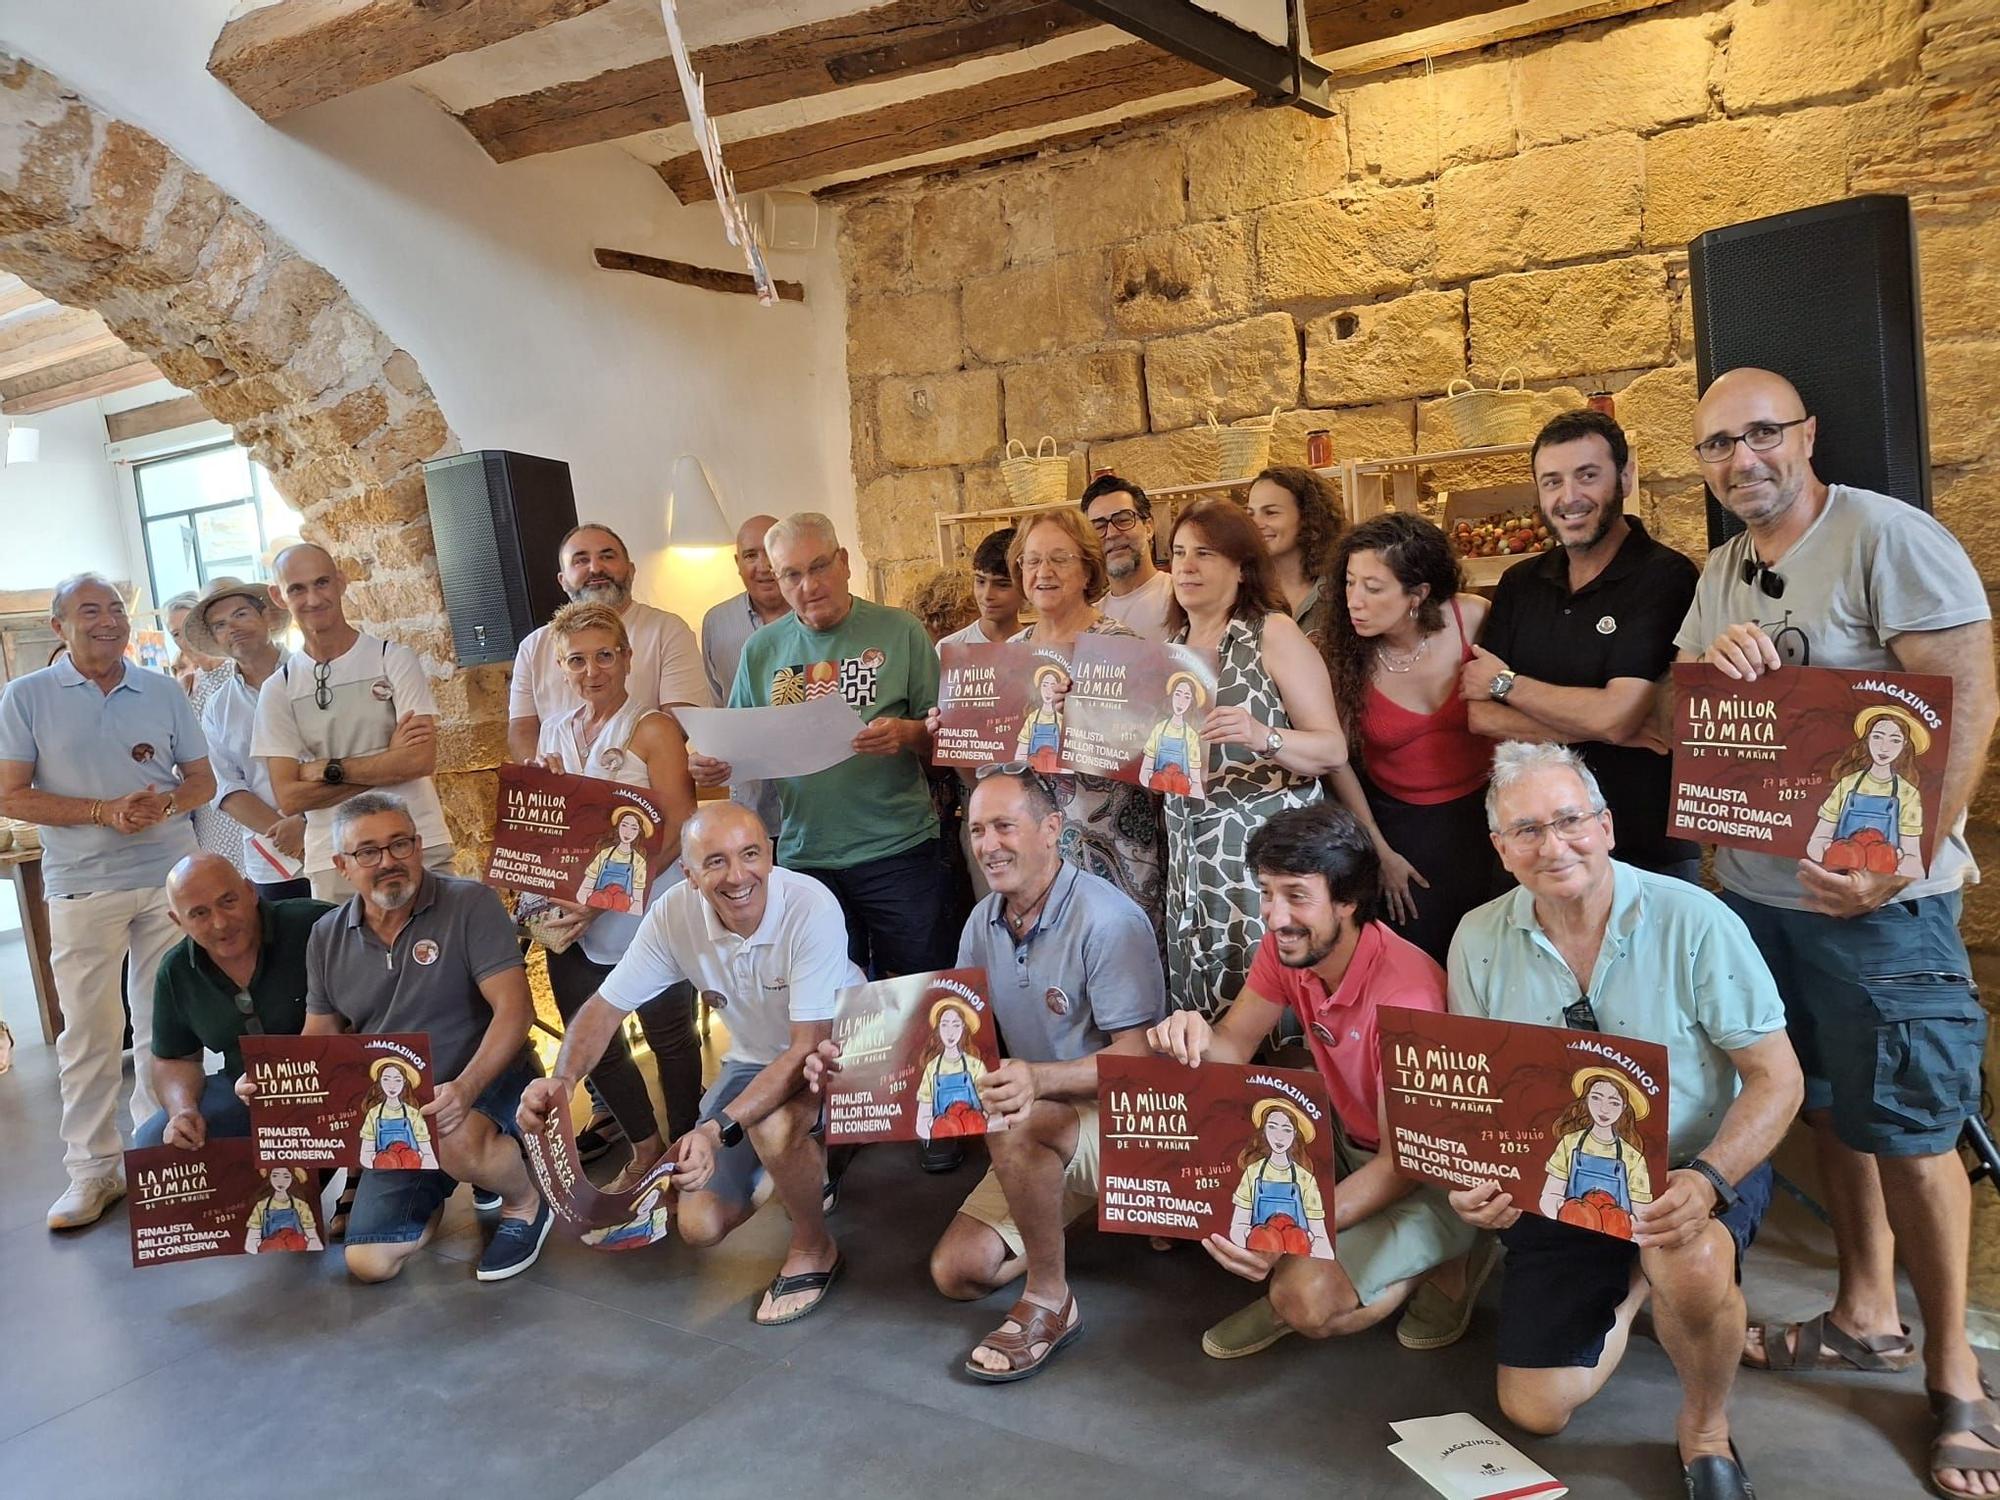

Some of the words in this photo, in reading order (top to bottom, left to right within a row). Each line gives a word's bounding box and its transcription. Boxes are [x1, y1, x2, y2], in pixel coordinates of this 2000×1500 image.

[948, 669, 960, 684] LA
[1077, 661, 1091, 679] LA
[947, 682, 994, 697] TOMACA
[1076, 680, 1123, 697] TOMACA
[1689, 697, 1711, 720] LA
[1718, 694, 1777, 720] MILLOR
[1864, 678, 1943, 729] MAGAZINOS
[939, 727, 979, 738] FINALISTA
[1065, 726, 1104, 743] FINALISTA
[1689, 721, 1774, 743] TOMACA
[937, 739, 968, 749] MILLOR
[970, 740, 1005, 751] TOMACA
[1063, 739, 1094, 753] MILLOR
[1095, 745, 1130, 761] TOMACA
[937, 750, 949, 759] EN
[949, 750, 994, 761] CONSERVA
[1062, 750, 1074, 760] EN
[1075, 753, 1120, 771] CONSERVA
[1693, 748, 1705, 757] DE
[1717, 748, 1729, 758] LA
[1737, 748, 1776, 761] MARINA
[508, 789, 523, 806] LA
[1678, 782, 1748, 804] FINALISTA
[1778, 789, 1807, 801] 2025
[508, 806, 564, 825] TOMACA
[619, 788, 662, 825] MAGAZINOS
[1676, 798, 1730, 818] MILLOR
[1731, 805, 1793, 828] TOMACA
[1675, 814, 1694, 828] EN
[1697, 818, 1773, 841] CONSERVA
[495, 847, 542, 864] FINALISTA
[492, 857, 529, 875] MILLOR
[530, 864, 569, 881] TOMACA
[489, 868, 504, 880] EN
[504, 871, 556, 890] CONSERVA
[933, 978, 986, 1012] MAGAZINOS
[372, 1040, 426, 1071] MAGAZINOS
[1395, 1043, 1419, 1069] LA
[1426, 1044, 1491, 1073] MILLOR
[256, 1062, 273, 1080] LA
[1579, 1039, 1660, 1096] MAGAZINOS
[256, 1077, 320, 1095] TOMACA
[1396, 1069, 1489, 1095] TOMACA
[831, 1091, 873, 1106] FINALISTA
[1111, 1091, 1132, 1113] LA
[1136, 1087, 1188, 1112] MILLOR
[1255, 1074, 1322, 1120] MAGAZINOS
[1404, 1094, 1418, 1105] DE
[1429, 1097, 1443, 1108] LA
[1451, 1100, 1493, 1115] MARINA
[831, 1107, 862, 1120] MILLOR
[864, 1103, 902, 1117] TOMACA
[258, 1127, 311, 1138] FINALISTA
[831, 1122, 843, 1134] EN
[844, 1119, 892, 1133] CONSERVA
[1112, 1114, 1188, 1134] TOMACA
[1395, 1126, 1468, 1156] FINALISTA
[1480, 1129, 1494, 1141] 27
[1498, 1130, 1513, 1141] DE
[1515, 1127, 1545, 1141] JULIO
[260, 1139, 300, 1149] MILLOR
[301, 1139, 346, 1149] TOMACA
[1117, 1140, 1129, 1149] DE
[1139, 1140, 1150, 1149] LA
[1157, 1139, 1190, 1151] MARINA
[1499, 1142, 1531, 1154] 2025
[261, 1150, 275, 1161] EN
[277, 1150, 335, 1160] CONSERVA
[1397, 1141, 1451, 1167] MILLOR
[1452, 1156, 1521, 1181] TOMACA
[1400, 1155, 1420, 1171] EN
[138, 1170, 158, 1187] LA
[162, 1162, 207, 1181] MILLOR
[1194, 1166, 1205, 1176] DE
[139, 1176, 207, 1200] TOMACA
[1106, 1176, 1171, 1194] FINALISTA
[1195, 1177, 1220, 1190] 2025
[1106, 1192, 1155, 1208] MILLOR
[1157, 1196, 1213, 1216] TOMACA
[1106, 1208, 1124, 1221] EN
[1127, 1210, 1199, 1229] CONSERVA
[137, 1223, 194, 1238] FINALISTA
[138, 1234, 182, 1249] MILLOR
[183, 1230, 230, 1243] TOMACA
[138, 1249, 156, 1260] EN
[157, 1241, 219, 1257] CONSERVA
[1441, 1439, 1502, 1457] MAGAZINOS
